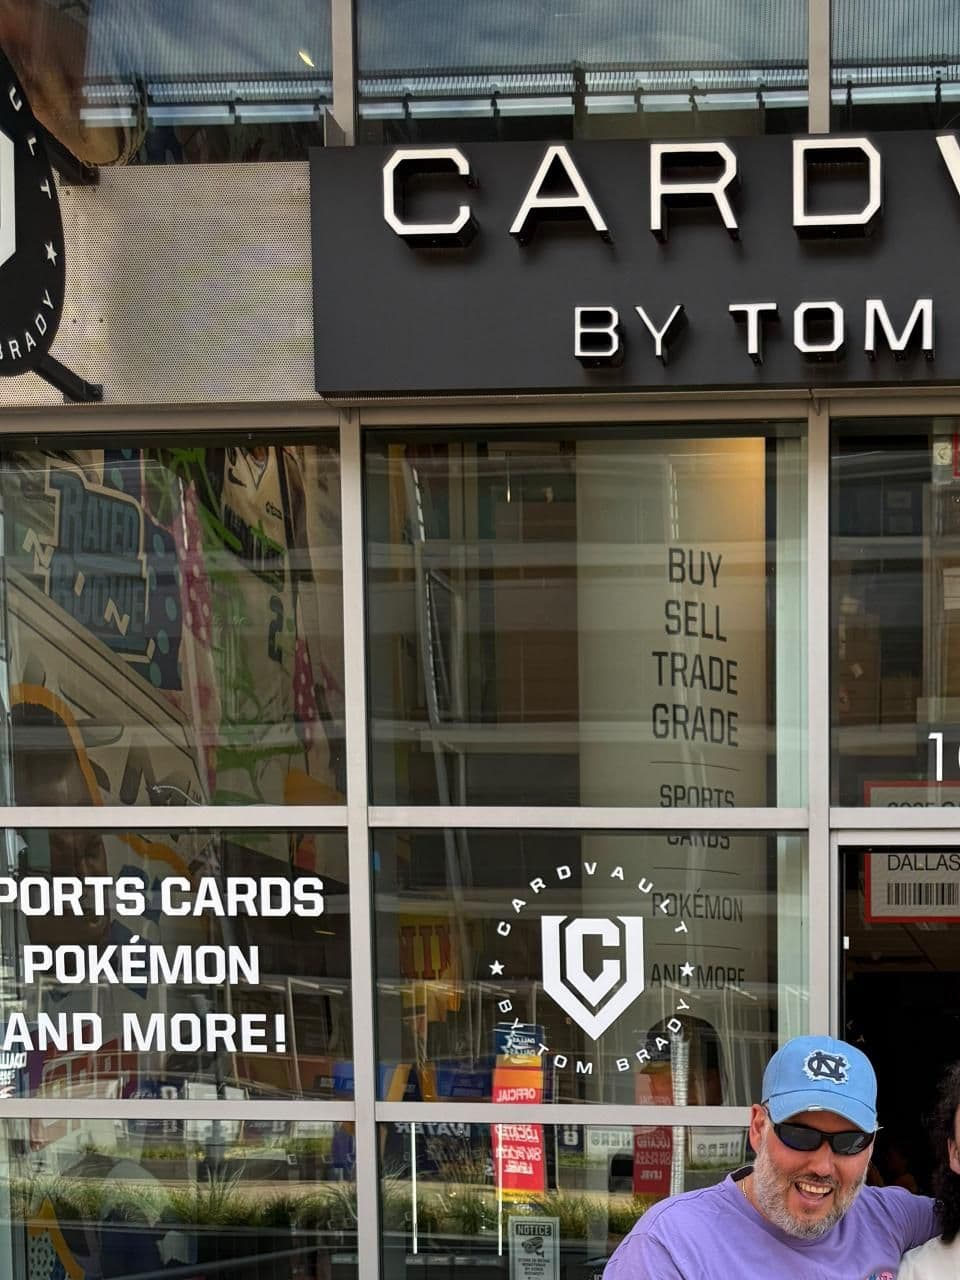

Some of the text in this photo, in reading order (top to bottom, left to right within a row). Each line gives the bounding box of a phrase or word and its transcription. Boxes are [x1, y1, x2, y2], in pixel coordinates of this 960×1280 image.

[0, 289, 54, 361] RADY
[574, 306, 681, 357] BY
[729, 299, 933, 354] TOM
[668, 547, 722, 588] BUY
[664, 599, 727, 642] SELL
[652, 651, 738, 695] TRADE
[652, 703, 739, 748] GRADE
[660, 785, 735, 808] SPORTS
[161, 877, 325, 917] CARDS
[497, 861, 689, 937] CARDVAULT
[652, 887, 744, 923] POKÉMON
[22, 934, 260, 985] POKÉMON
[3, 1012, 286, 1053] AND MORE!
[537, 1043, 594, 1075] TOM
[616, 998, 691, 1072] BRADY
[516, 1224, 553, 1236] NOTICE
